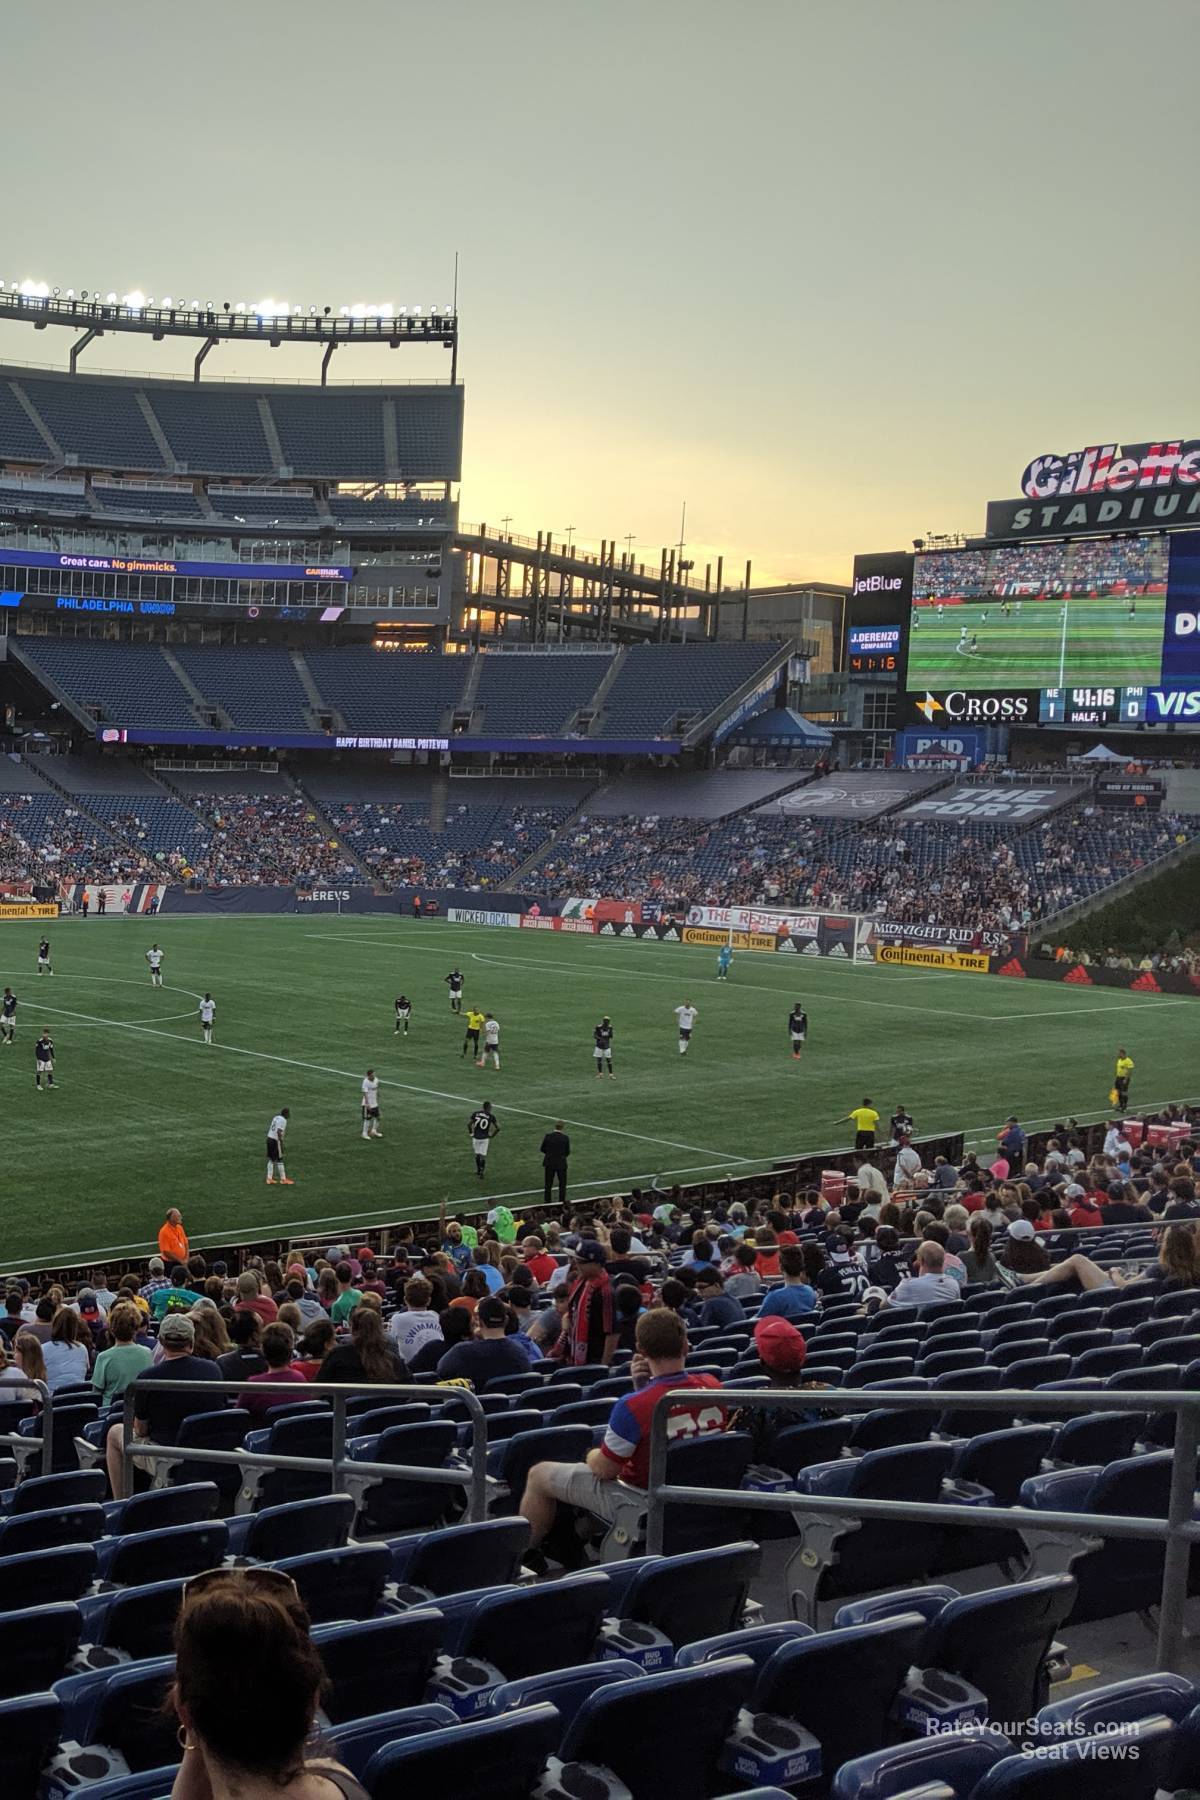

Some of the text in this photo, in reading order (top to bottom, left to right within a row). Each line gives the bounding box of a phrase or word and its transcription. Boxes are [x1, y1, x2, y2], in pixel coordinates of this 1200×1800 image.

[60, 556, 177, 573] Great cars. No gimmicks.
[853, 575, 901, 596] jetBlue
[57, 598, 133, 612] PHILADELPHIA
[851, 631, 899, 643] J.DERENZO
[860, 642, 893, 650] COMPANIES
[1046, 689, 1059, 698] NE
[1072, 688, 1115, 706] 41:16
[1127, 687, 1143, 697] PHI
[1049, 703, 1055, 718] 1
[1128, 702, 1138, 716] 0
[1071, 712, 1099, 722] HALF:
[336, 737, 357, 747] HAPPY
[358, 737, 392, 748] BIRTHDAY
[393, 738, 416, 749] DANIEL
[951, 788, 1056, 803] THE
[902, 801, 1051, 817] FORT
[38, 907, 55, 915] TIRE
[874, 922, 947, 940] MIDNIGHT
[949, 929, 1000, 945] RIDRS
[751, 937, 773, 947] TIRE
[881, 947, 945, 964] Continental
[959, 957, 985, 969] TIRE
[474, 1116, 488, 1130] 70
